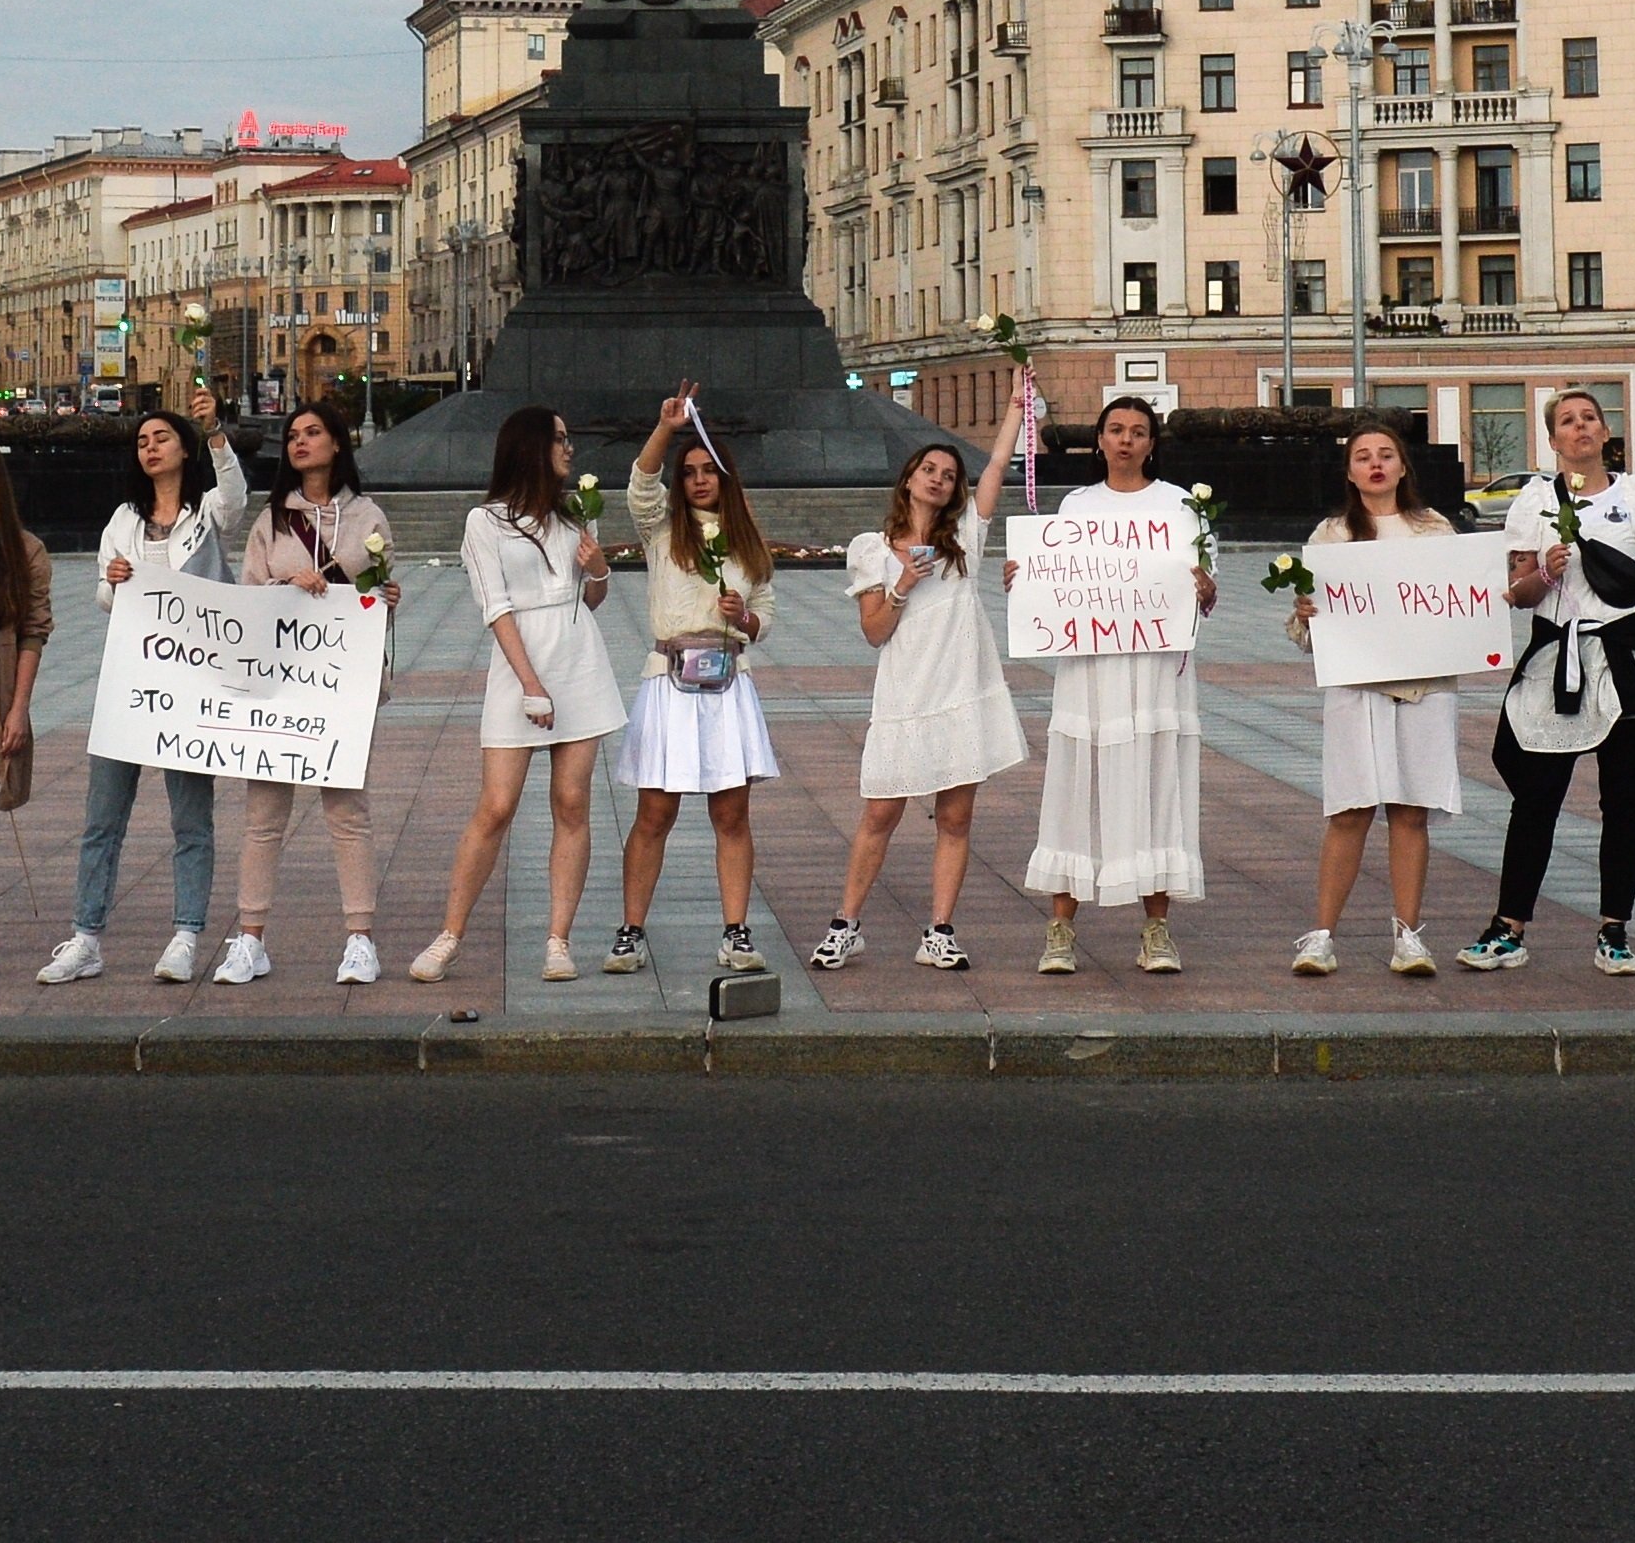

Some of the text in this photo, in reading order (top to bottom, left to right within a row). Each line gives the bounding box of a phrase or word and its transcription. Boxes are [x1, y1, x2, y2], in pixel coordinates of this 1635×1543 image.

[1041, 519, 1171, 552] СЭРЦАМ
[1026, 553, 1139, 583] АДДАНЫЯ
[1053, 582, 1170, 614] РОДНАЙ
[1324, 581, 1492, 618] МЫ РАЗАМ
[196, 605, 244, 645] ЧТО
[275, 617, 348, 652] МОЙ
[1032, 616, 1172, 654] ЗЯМЛІ
[142, 633, 342, 693] ГОЛОС ТИХИЙ
[129, 688, 327, 735] ЭТО НЕ ПОВОД
[156, 731, 340, 784] МОЛЧАТЬ!
